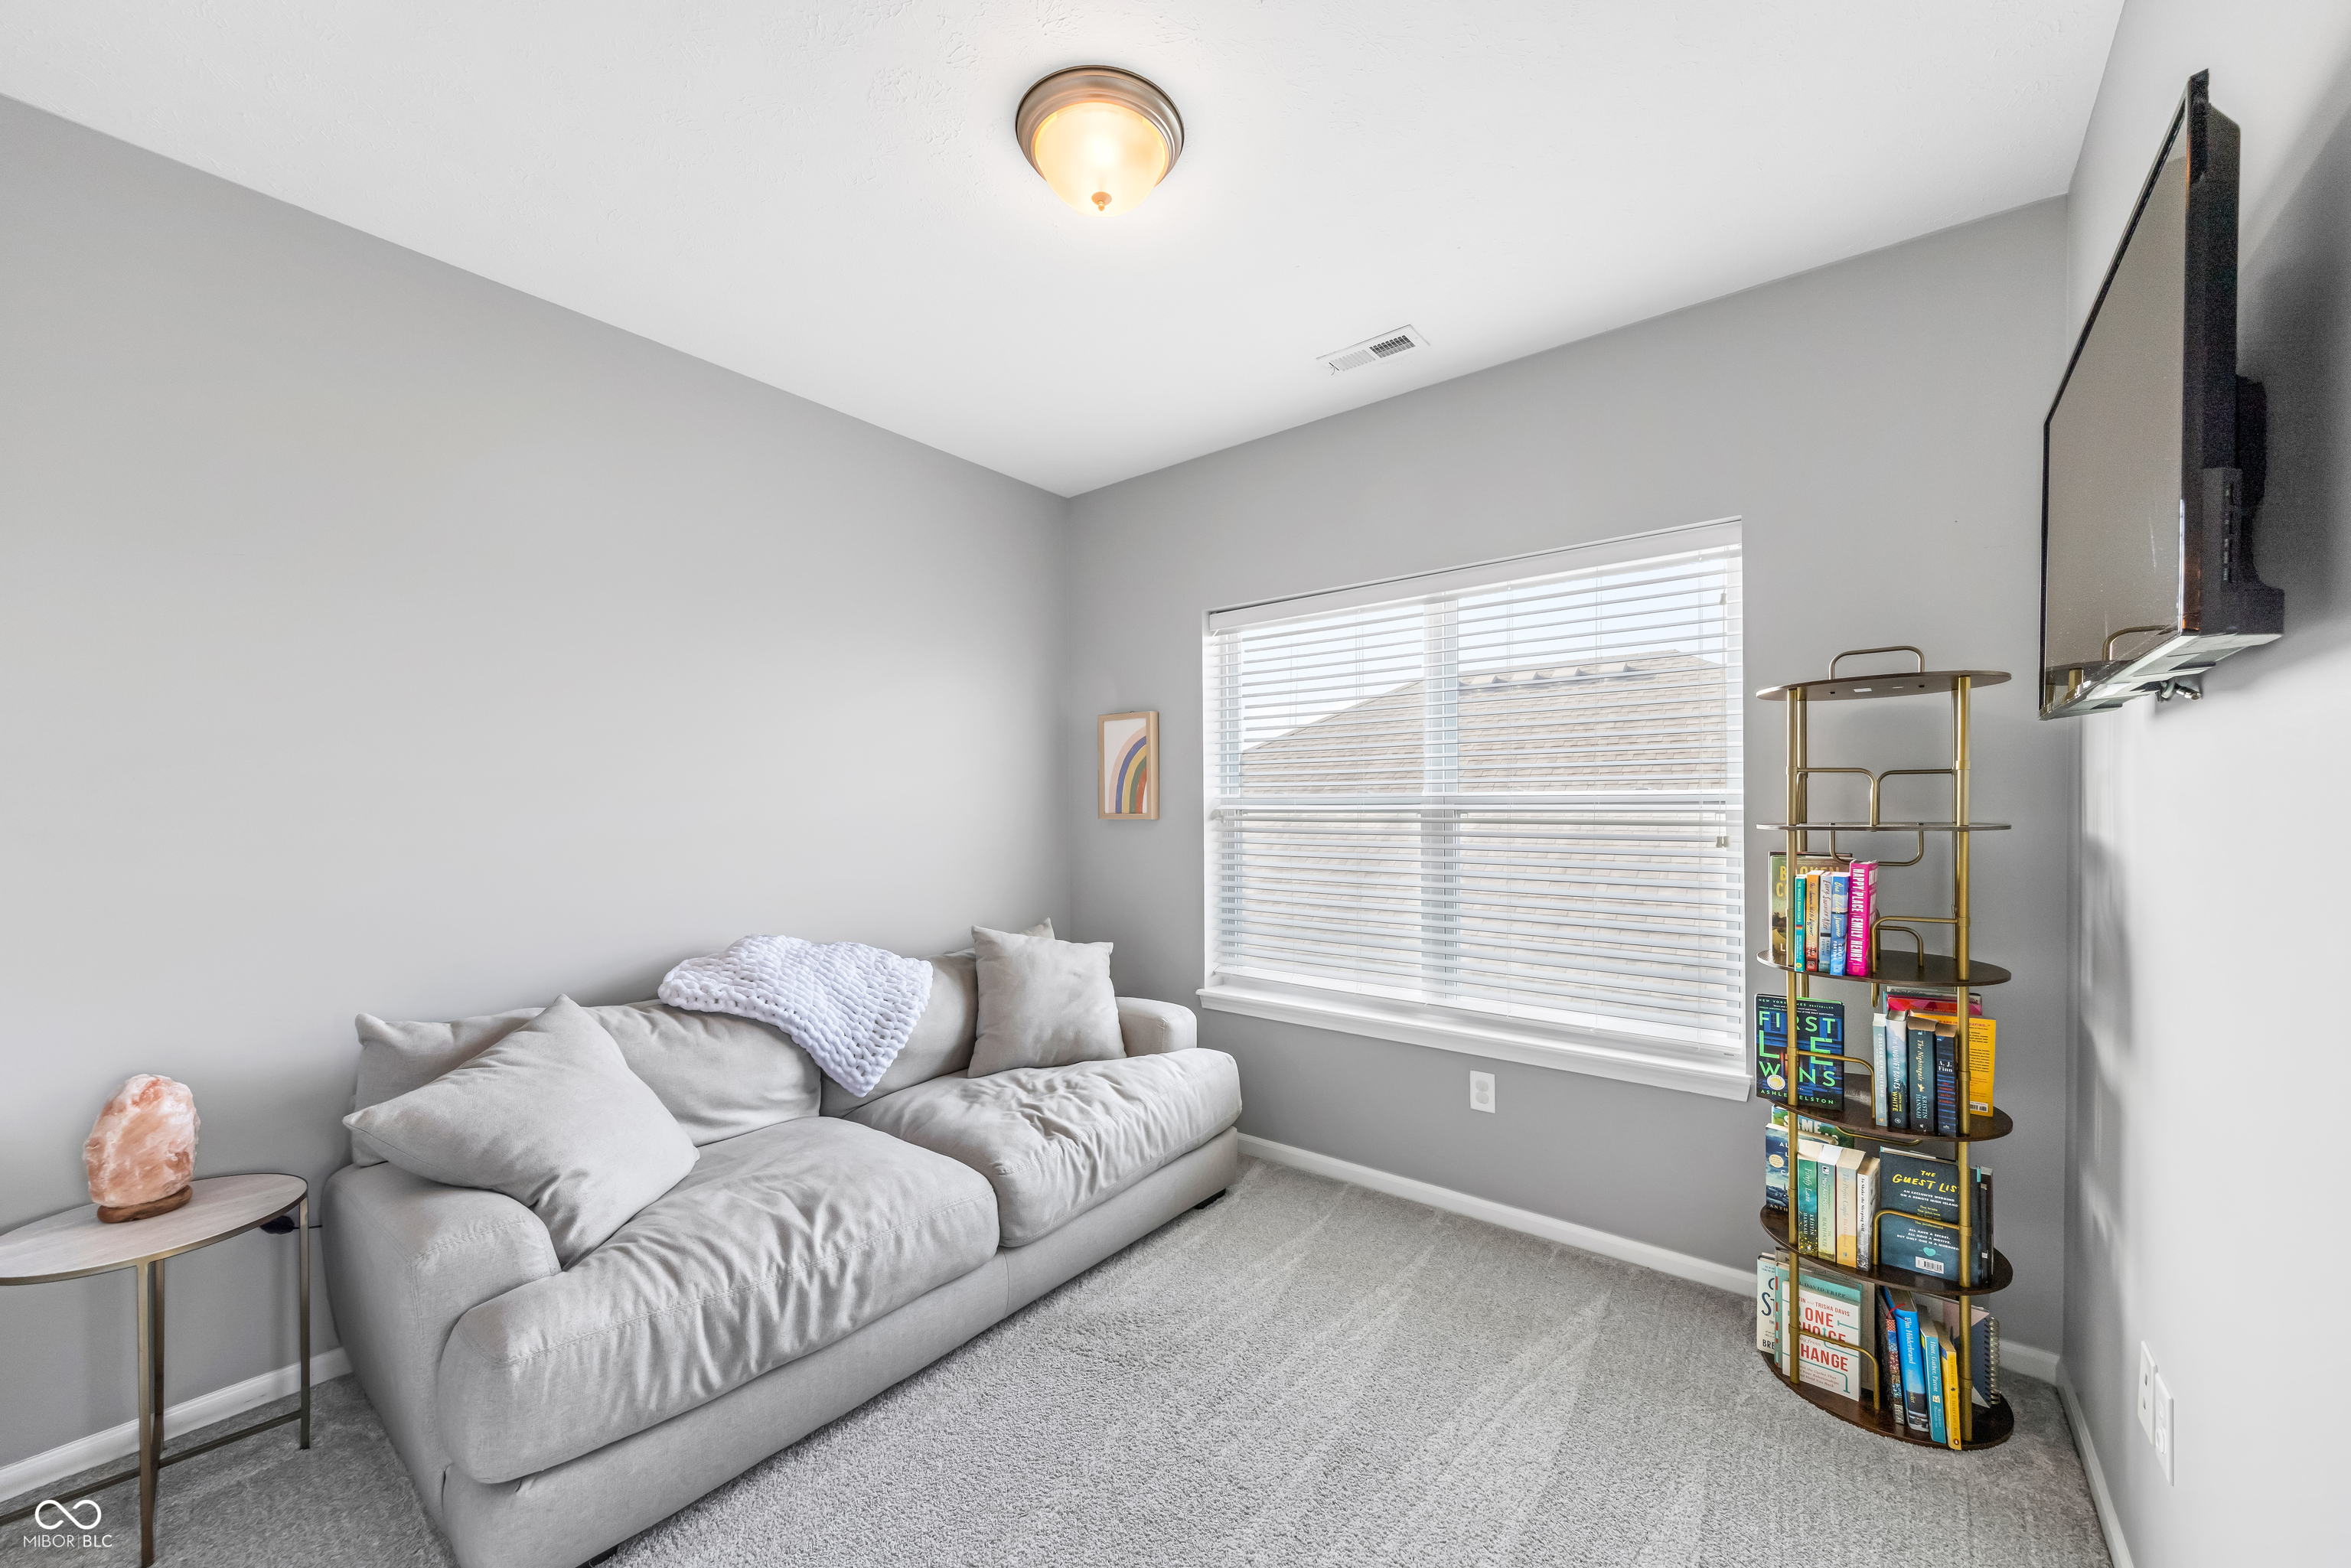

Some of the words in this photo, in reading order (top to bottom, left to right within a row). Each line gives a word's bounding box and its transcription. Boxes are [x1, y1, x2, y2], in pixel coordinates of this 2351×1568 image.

[1834, 882, 1844, 892] One
[1852, 869, 1865, 890] HAPPY
[1851, 892, 1864, 913] PLACE
[1833, 914, 1842, 937] Summer
[1850, 918, 1864, 938] EMILY
[1850, 940, 1864, 963] HENRY
[1759, 1029, 1834, 1067] LE
[1892, 1045, 1900, 1070] UNQUIET
[1759, 1061, 1836, 1087] WNS
[1916, 1051, 1925, 1081] Nightingale
[1760, 1089, 1789, 1097] ASHLE
[1798, 1095, 1834, 1104] ELSTON
[1783, 1115, 1822, 1134] SME
[1802, 1168, 1812, 1186] Firefly
[1892, 1173, 1936, 1190] GUEST
[1939, 1182, 1959, 1193] LIS
[1920, 1169, 1936, 1178] THE
[1805, 1307, 1834, 1328] ONE
[1815, 1302, 1834, 1312] TRISHA
[1834, 1307, 1850, 1317] DAVIS
[1904, 1317, 1912, 1328] Elin
[1807, 1338, 1821, 1347] from
[1906, 1330, 1916, 1364] Hilderbrand
[1801, 1343, 1848, 1372] HANGE
